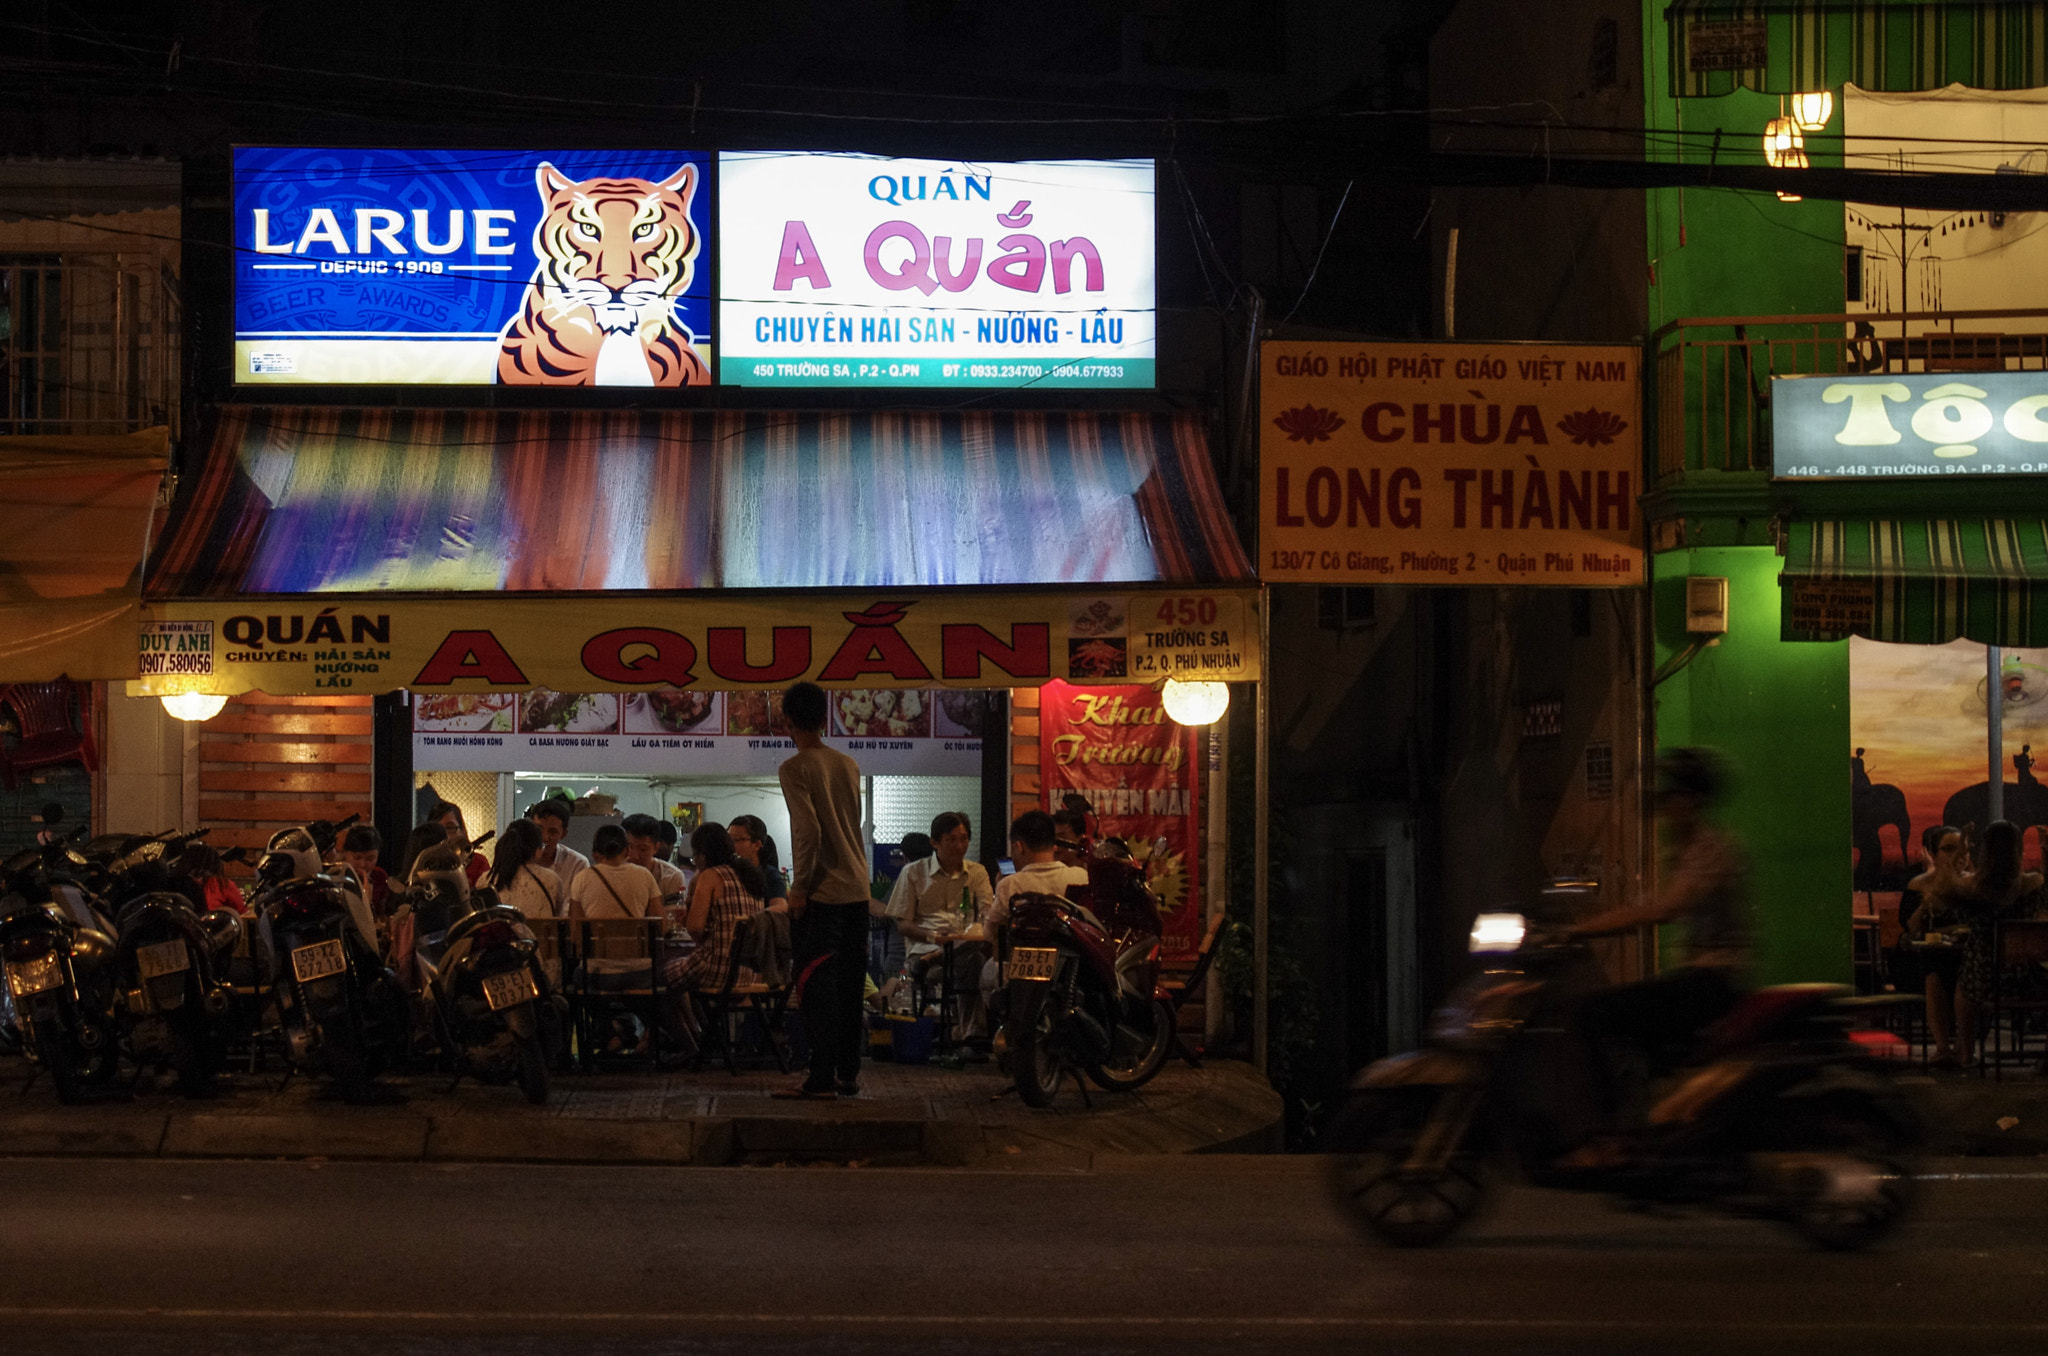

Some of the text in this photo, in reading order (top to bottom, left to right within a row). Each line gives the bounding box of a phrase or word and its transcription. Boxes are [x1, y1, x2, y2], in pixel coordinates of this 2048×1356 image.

[868, 167, 991, 206] QUÁN
[252, 207, 516, 255] LARUE
[395, 260, 443, 274] 1909
[773, 220, 832, 292] A
[249, 285, 450, 323] BEER AWARDS
[755, 311, 853, 343] CHUYÊN
[753, 363, 774, 377] 450
[776, 361, 830, 377] TRƯỜNG
[860, 363, 878, 377] P.2
[888, 363, 920, 378] Q.PN
[942, 363, 961, 377] ĐT
[970, 363, 1041, 377] 0933.234700
[1052, 363, 1125, 378] 0904.677933
[1276, 351, 1626, 387] GIÁO HỘI PHẬT GIÁO VIỆT NAM
[1361, 389, 1549, 445] CHÙA
[1787, 465, 1819, 477] 446
[1836, 464, 1867, 476] 448
[1871, 462, 1940, 476] TRƯỜNG
[1945, 463, 1968, 475] SA
[1982, 463, 2006, 474] P.2
[1276, 454, 1630, 531] LONG THÀNH
[1271, 550, 1631, 577] 130/7 Cô Giang, Phường 2 Quận Phú Nhuận
[1156, 598, 1217, 626] 450
[141, 633, 211, 651] DUY ANH
[222, 607, 391, 650] QUÁN
[1145, 629, 1230, 648] TRƯỜNG SA
[140, 653, 211, 673] 0907.580056
[225, 647, 391, 662] CHUYÊN: HẢI SẢN
[411, 629, 531, 685] A
[1136, 649, 1241, 673] P.2, Q. PHÚ NHUẬN
[1068, 693, 1167, 726] Khai
